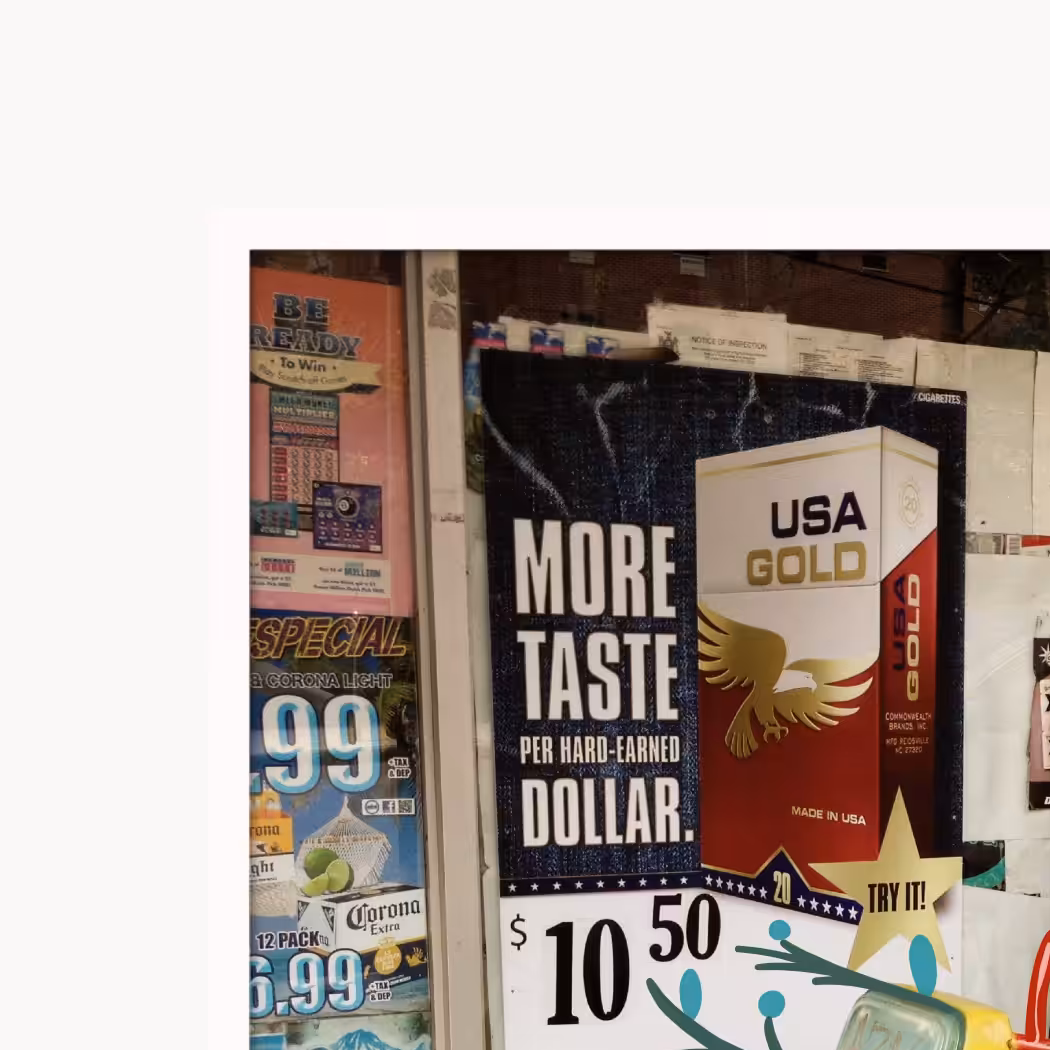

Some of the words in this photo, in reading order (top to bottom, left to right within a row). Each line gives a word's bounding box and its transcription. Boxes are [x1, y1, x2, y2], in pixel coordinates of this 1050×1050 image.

[272, 292, 330, 325] BE
[250, 324, 362, 358] READY
[281, 357, 294, 369] To
[299, 359, 326, 372] Win
[918, 392, 961, 405] CIGARETTES
[771, 490, 866, 539] USA
[513, 518, 677, 618] MORE
[746, 541, 866, 586] GOLD
[892, 574, 908, 672] USA
[906, 573, 921, 702] GOLD
[251, 673, 263, 688] &
[267, 673, 341, 688] CORONA
[343, 673, 393, 688] LIGHT
[517, 630, 679, 720] TASTE
[885, 711, 932, 721] COMMONWEALTH
[520, 736, 553, 764] PER
[560, 736, 680, 764] HARD-EARNED
[521, 777, 694, 847] DOLLAR.
[791, 805, 824, 820] MADE
[826, 810, 839, 821] IN
[841, 813, 867, 826] USA
[773, 870, 791, 905] 20
[868, 882, 900, 913] TRY
[905, 881, 926, 911] IT!
[347, 899, 421, 931] Corona
[371, 923, 400, 936] Extra
[257, 933, 276, 949] 12
[278, 930, 320, 949] PACK
[510, 913, 527, 951] $
[546, 919, 630, 1025] 10
[649, 893, 721, 962] 50
[377, 991, 391, 1001] DEP
